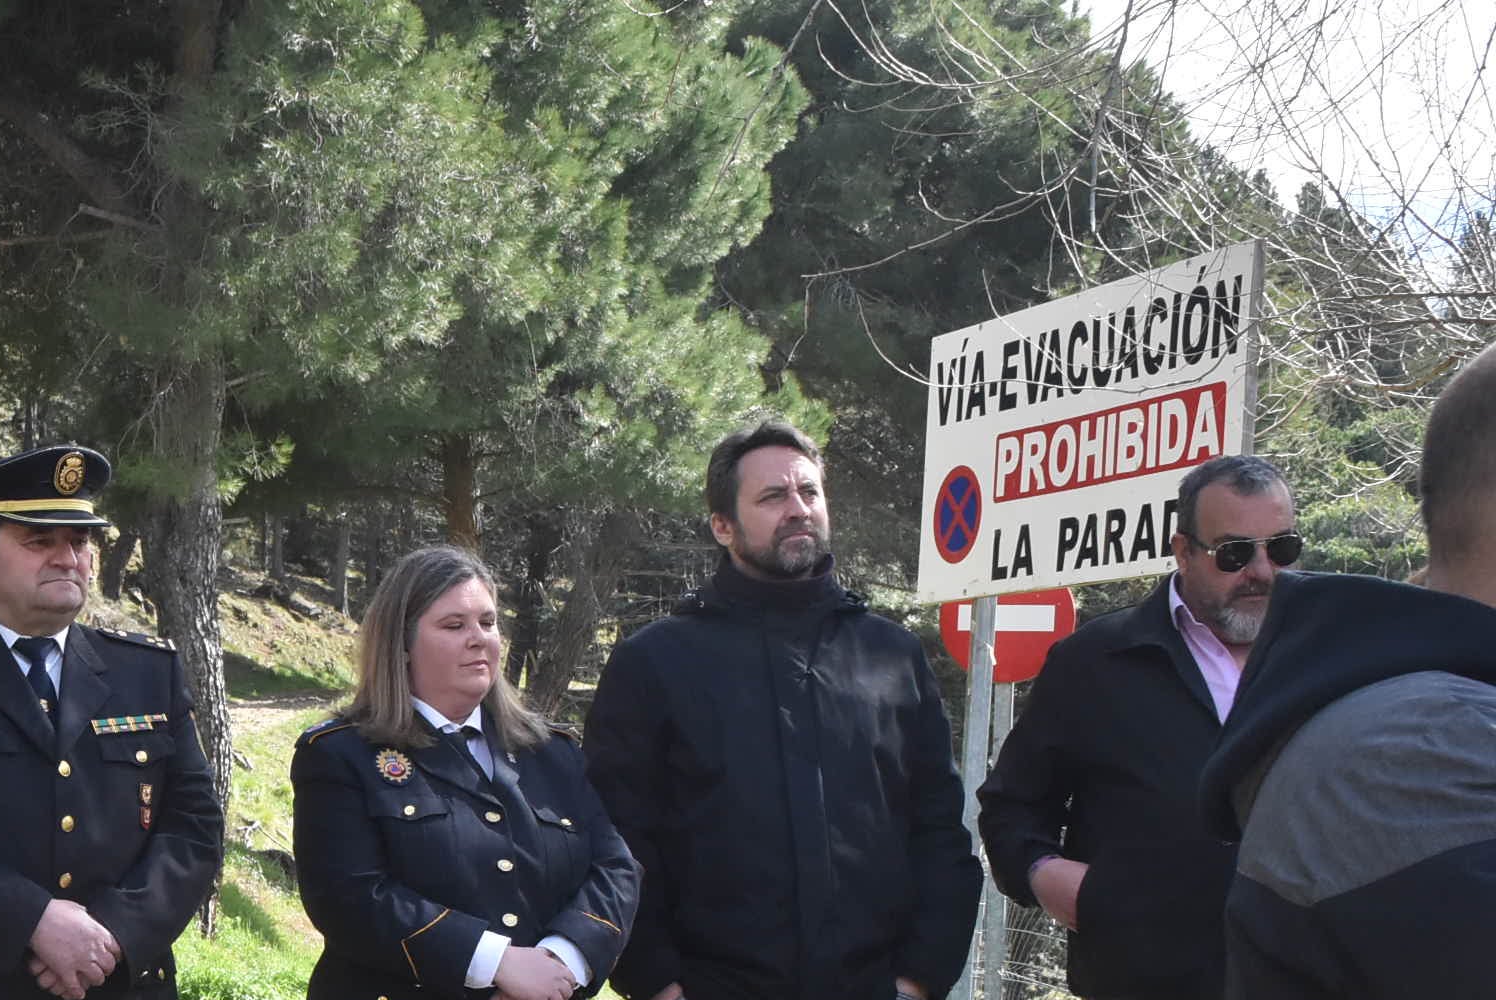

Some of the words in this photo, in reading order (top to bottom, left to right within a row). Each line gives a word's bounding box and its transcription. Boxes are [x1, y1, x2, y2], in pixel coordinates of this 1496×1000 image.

[937, 265, 1243, 426] VÍA-EVACUACIÓN
[996, 390, 1220, 498] PROHIBIDA
[991, 523, 1034, 580] LA
[1056, 500, 1179, 572] PARAD
